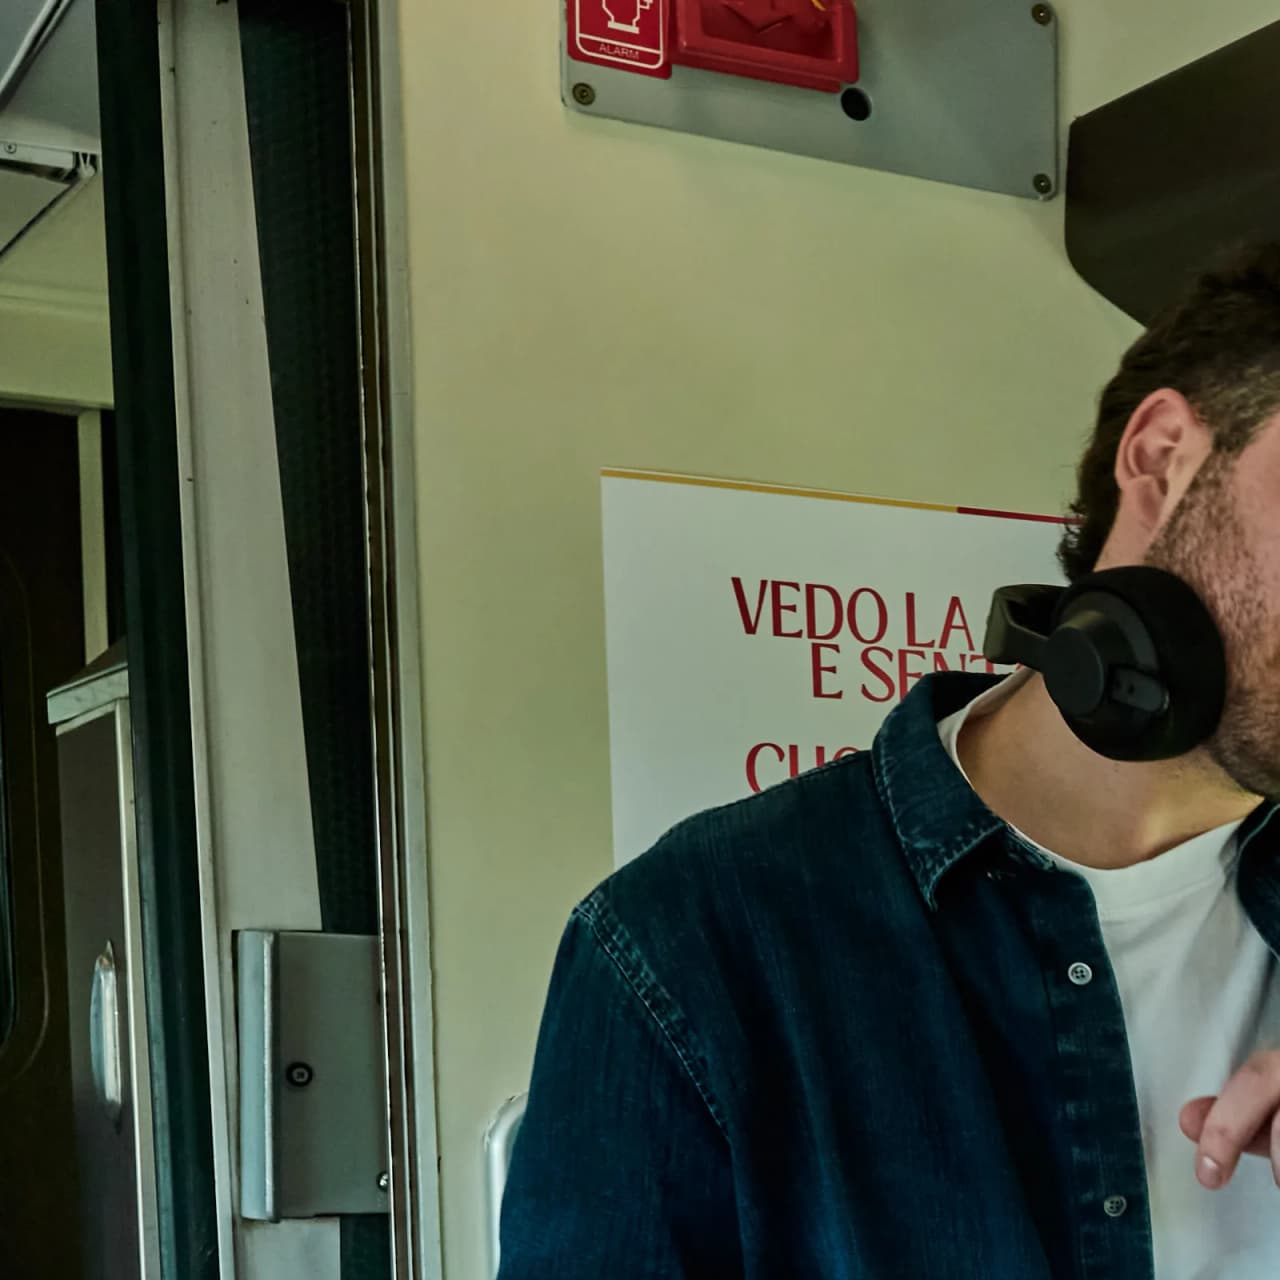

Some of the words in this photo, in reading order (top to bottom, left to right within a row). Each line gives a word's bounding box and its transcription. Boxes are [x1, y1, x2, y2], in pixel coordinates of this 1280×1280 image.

[599, 43, 640, 60] ALARM
[731, 576, 888, 644] VEDO
[905, 592, 976, 652] LA
[811, 642, 843, 700] E
